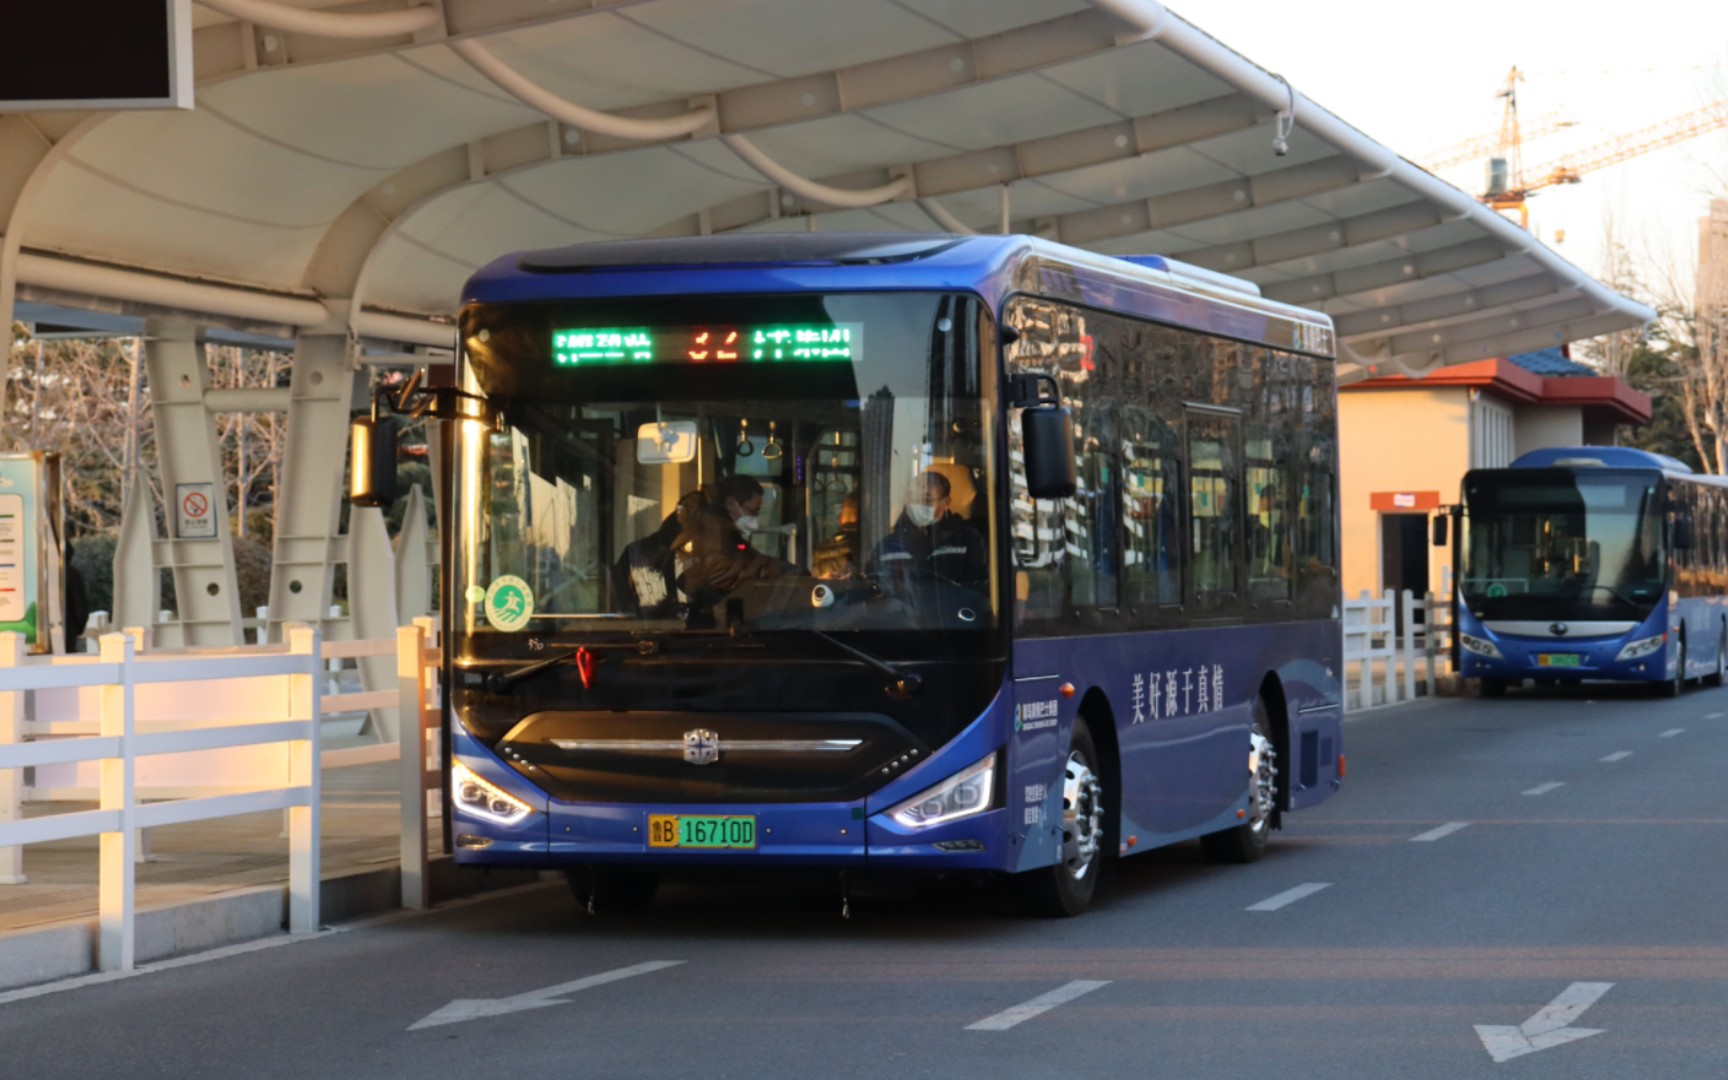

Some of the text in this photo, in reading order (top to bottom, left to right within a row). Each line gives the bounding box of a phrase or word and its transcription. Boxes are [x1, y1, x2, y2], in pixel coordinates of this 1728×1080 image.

[1132, 664, 1224, 724] 美好源于真情
